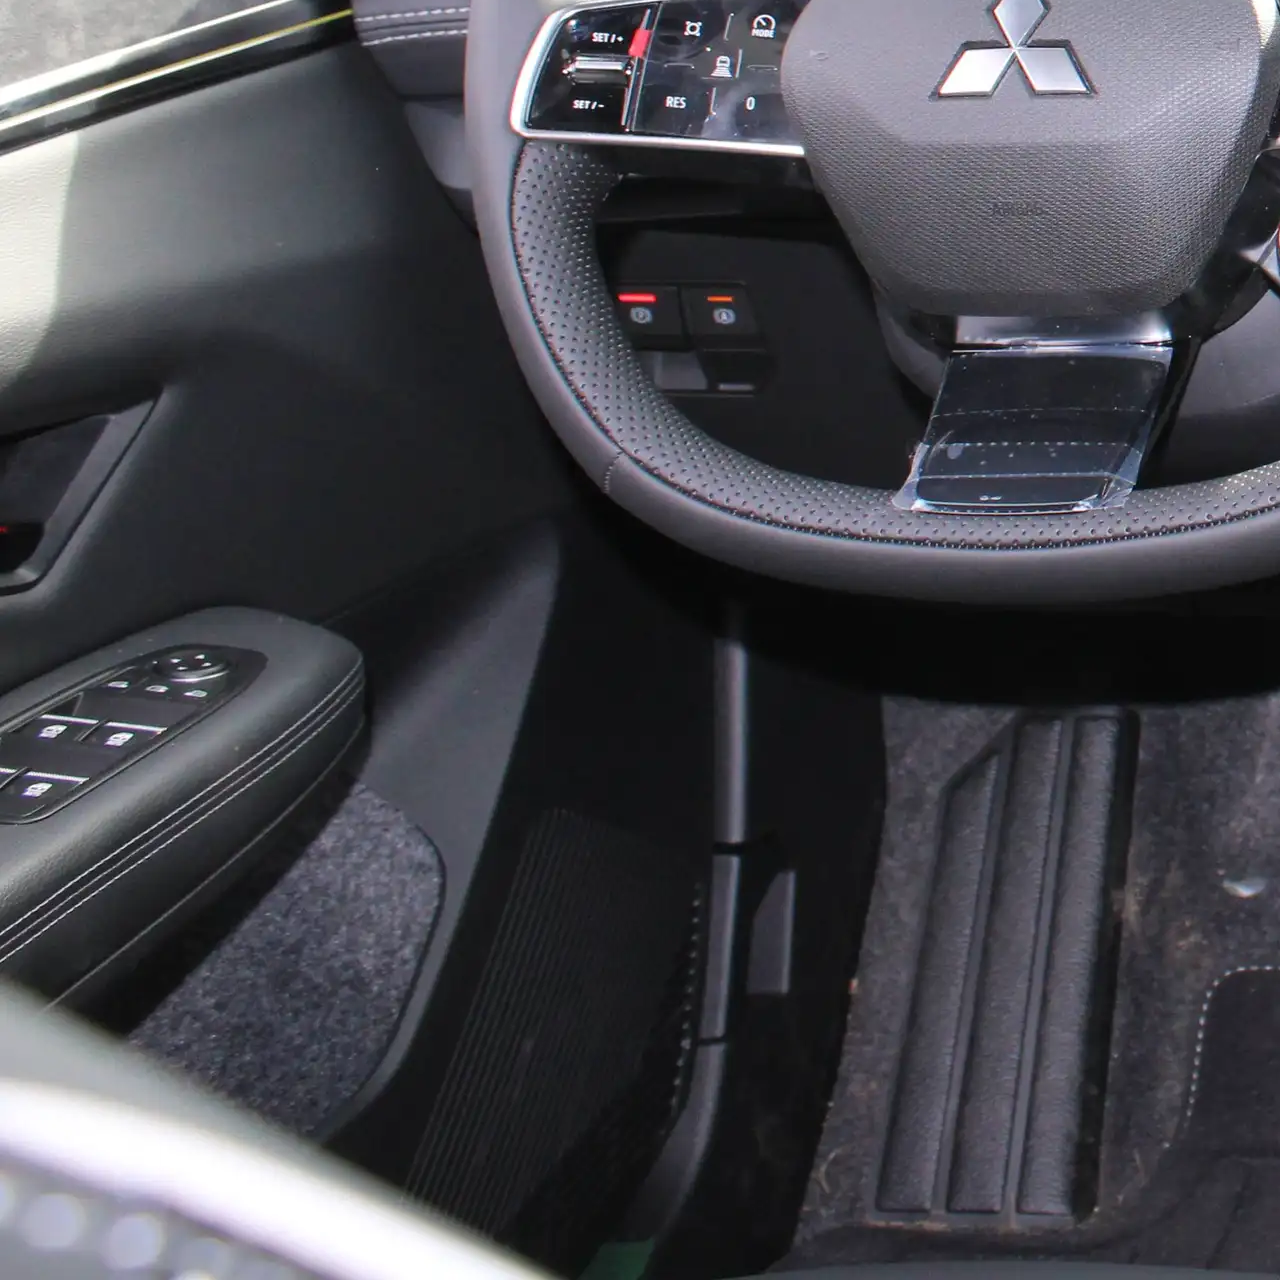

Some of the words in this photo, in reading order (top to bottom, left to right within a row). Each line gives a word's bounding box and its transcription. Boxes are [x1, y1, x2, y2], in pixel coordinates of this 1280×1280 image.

[592, 32, 609, 43] SET
[751, 29, 775, 38] MODE
[572, 99, 591, 110] SET
[665, 96, 687, 109] RES
